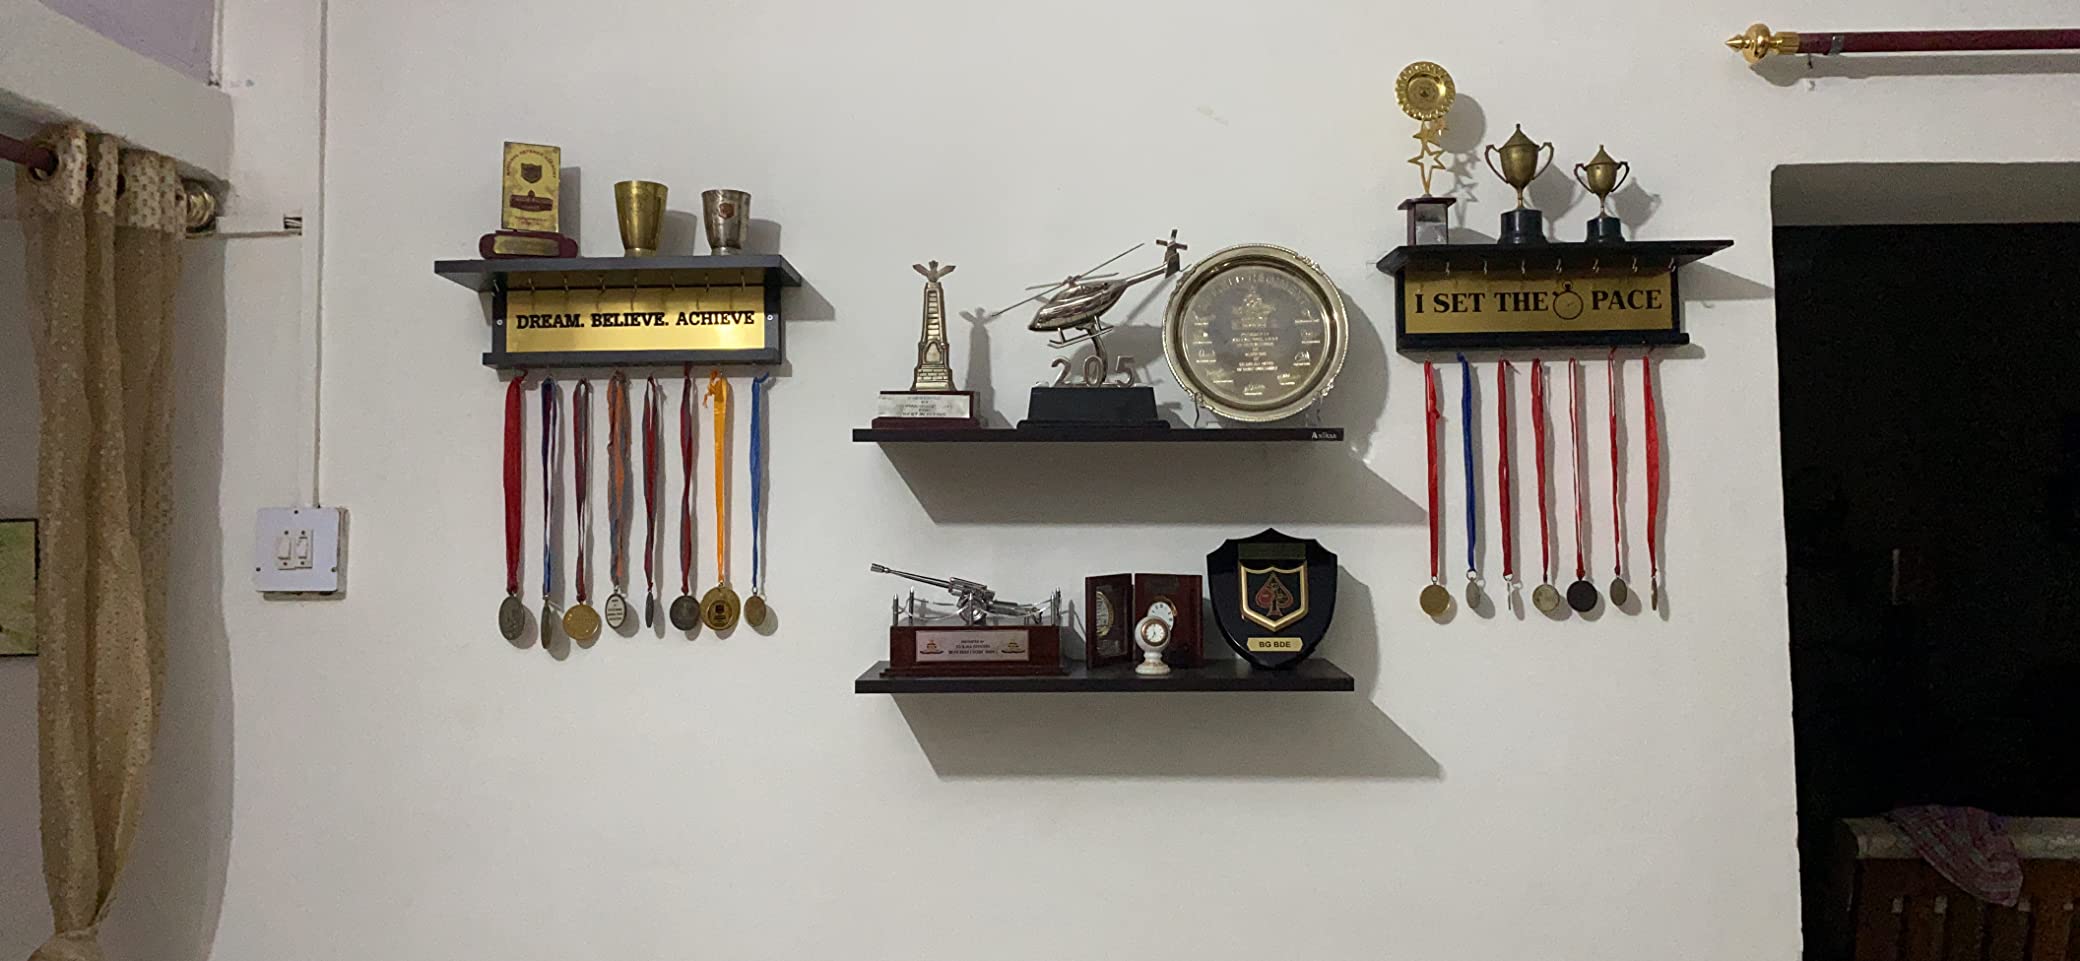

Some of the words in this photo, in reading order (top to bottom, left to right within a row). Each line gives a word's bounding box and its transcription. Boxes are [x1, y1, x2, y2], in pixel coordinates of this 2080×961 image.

[1415, 294, 1424, 314] I
[1433, 293, 1485, 313] SET
[1494, 291, 1548, 312] THE
[1592, 289, 1662, 311] PACE
[516, 313, 585, 329] DREAM.
[591, 311, 669, 328] BELIEVE.
[676, 310, 754, 326] ACHIEVE
[1051, 355, 1135, 388] 205
